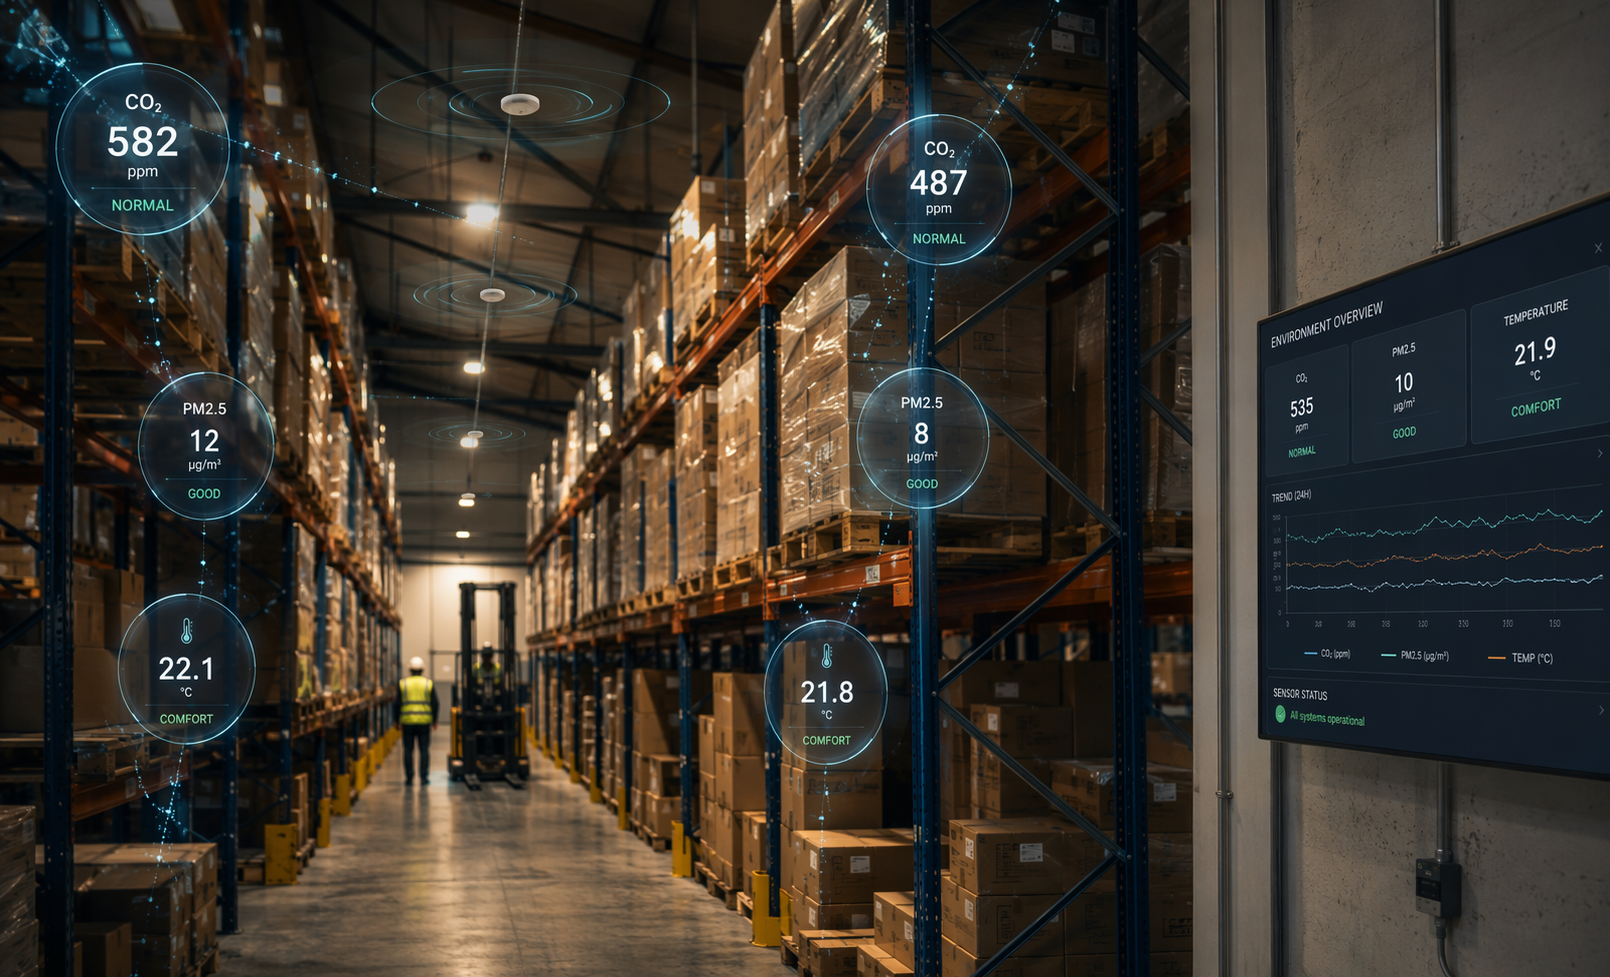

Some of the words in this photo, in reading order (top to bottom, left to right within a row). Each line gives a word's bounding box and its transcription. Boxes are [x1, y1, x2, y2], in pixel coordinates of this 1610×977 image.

[1503, 298, 1569, 327] TEMPERATURE
[1271, 317, 1332, 348] ENVIRONMENT
[1333, 300, 1384, 329] OVERVIEW
[1392, 341, 1416, 358] PM2.5
[1514, 336, 1556, 366] 21.9
[1395, 372, 1413, 393] 10
[1529, 369, 1541, 381] °C
[1290, 396, 1314, 418] 535
[1511, 397, 1562, 418] COMFORT
[1295, 422, 1309, 434] ppm
[1392, 425, 1417, 440] GOOD
[1288, 445, 1316, 458] NORMAL
[1271, 491, 1293, 503] TREND
[1294, 488, 1312, 501] (24H)
[1333, 649, 1351, 660] (ppm)
[1401, 650, 1423, 660] PM2.5
[1511, 652, 1536, 663] TEMP
[1273, 687, 1300, 699] SENSOR
[1301, 689, 1328, 701] STATUS
[1290, 710, 1299, 720] All
[1299, 712, 1326, 724] systems
[1327, 715, 1365, 727] operational
